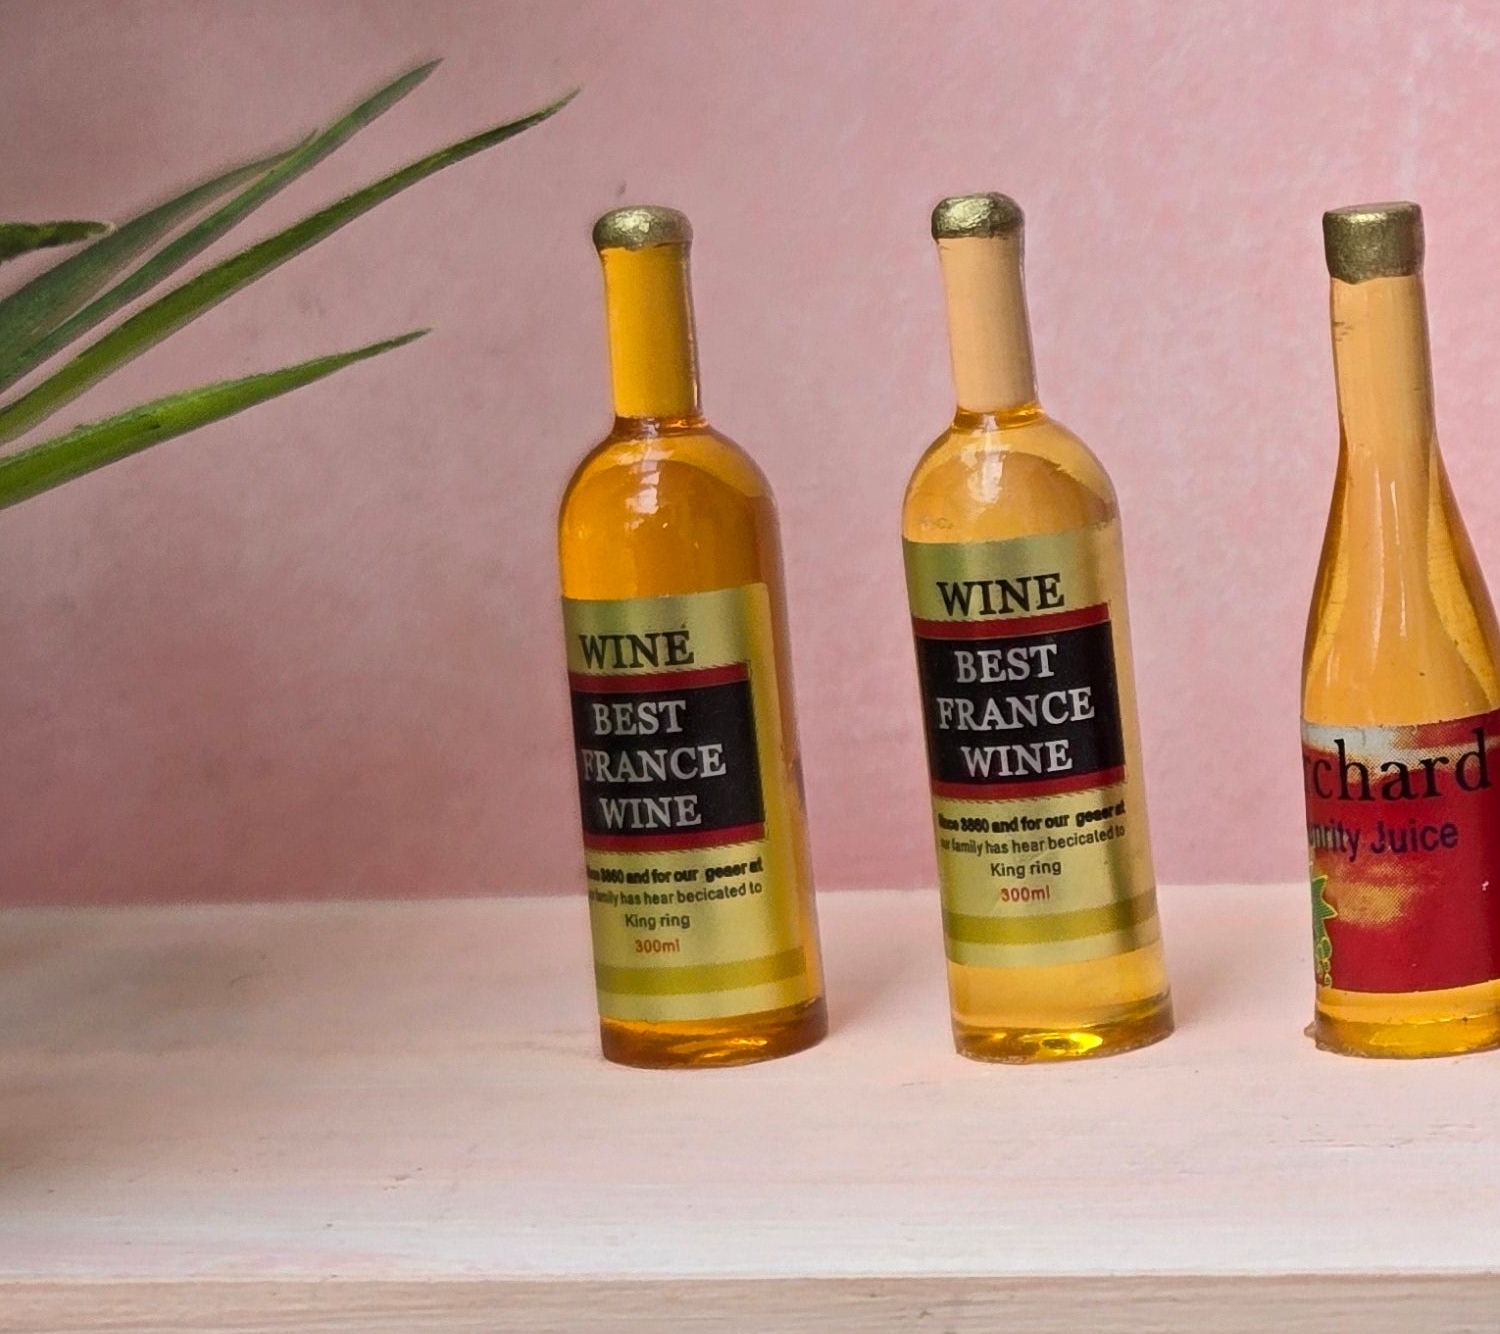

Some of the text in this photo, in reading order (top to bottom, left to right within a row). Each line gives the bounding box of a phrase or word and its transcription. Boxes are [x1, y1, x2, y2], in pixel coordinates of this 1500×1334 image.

[936, 573, 1066, 617] WINE
[579, 629, 695, 670] WINE
[954, 643, 1058, 684] BEST
[593, 700, 687, 736] BEST
[936, 687, 1095, 731] FRANCE
[581, 743, 727, 783] FRANCE
[961, 739, 1073, 778] WINE
[599, 795, 702, 829] WINE
[991, 816, 1019, 833] and
[1020, 816, 1043, 832] for
[1045, 814, 1070, 829] our
[952, 837, 984, 857] family
[985, 840, 1009, 854] has
[1012, 839, 1045, 855] hear
[1047, 826, 1114, 850] becicated
[1115, 824, 1126, 838] to
[1370, 818, 1459, 855] Juice
[626, 869, 650, 884] and
[651, 868, 672, 883] for
[674, 869, 699, 882] our
[990, 860, 1062, 879] King ring
[620, 891, 642, 905] has
[643, 891, 675, 905] hear
[676, 883, 747, 904] becicated
[748, 881, 763, 895] to
[1001, 885, 1050, 902] 300ml
[625, 913, 691, 930] King ring
[635, 938, 680, 953] 300ml
